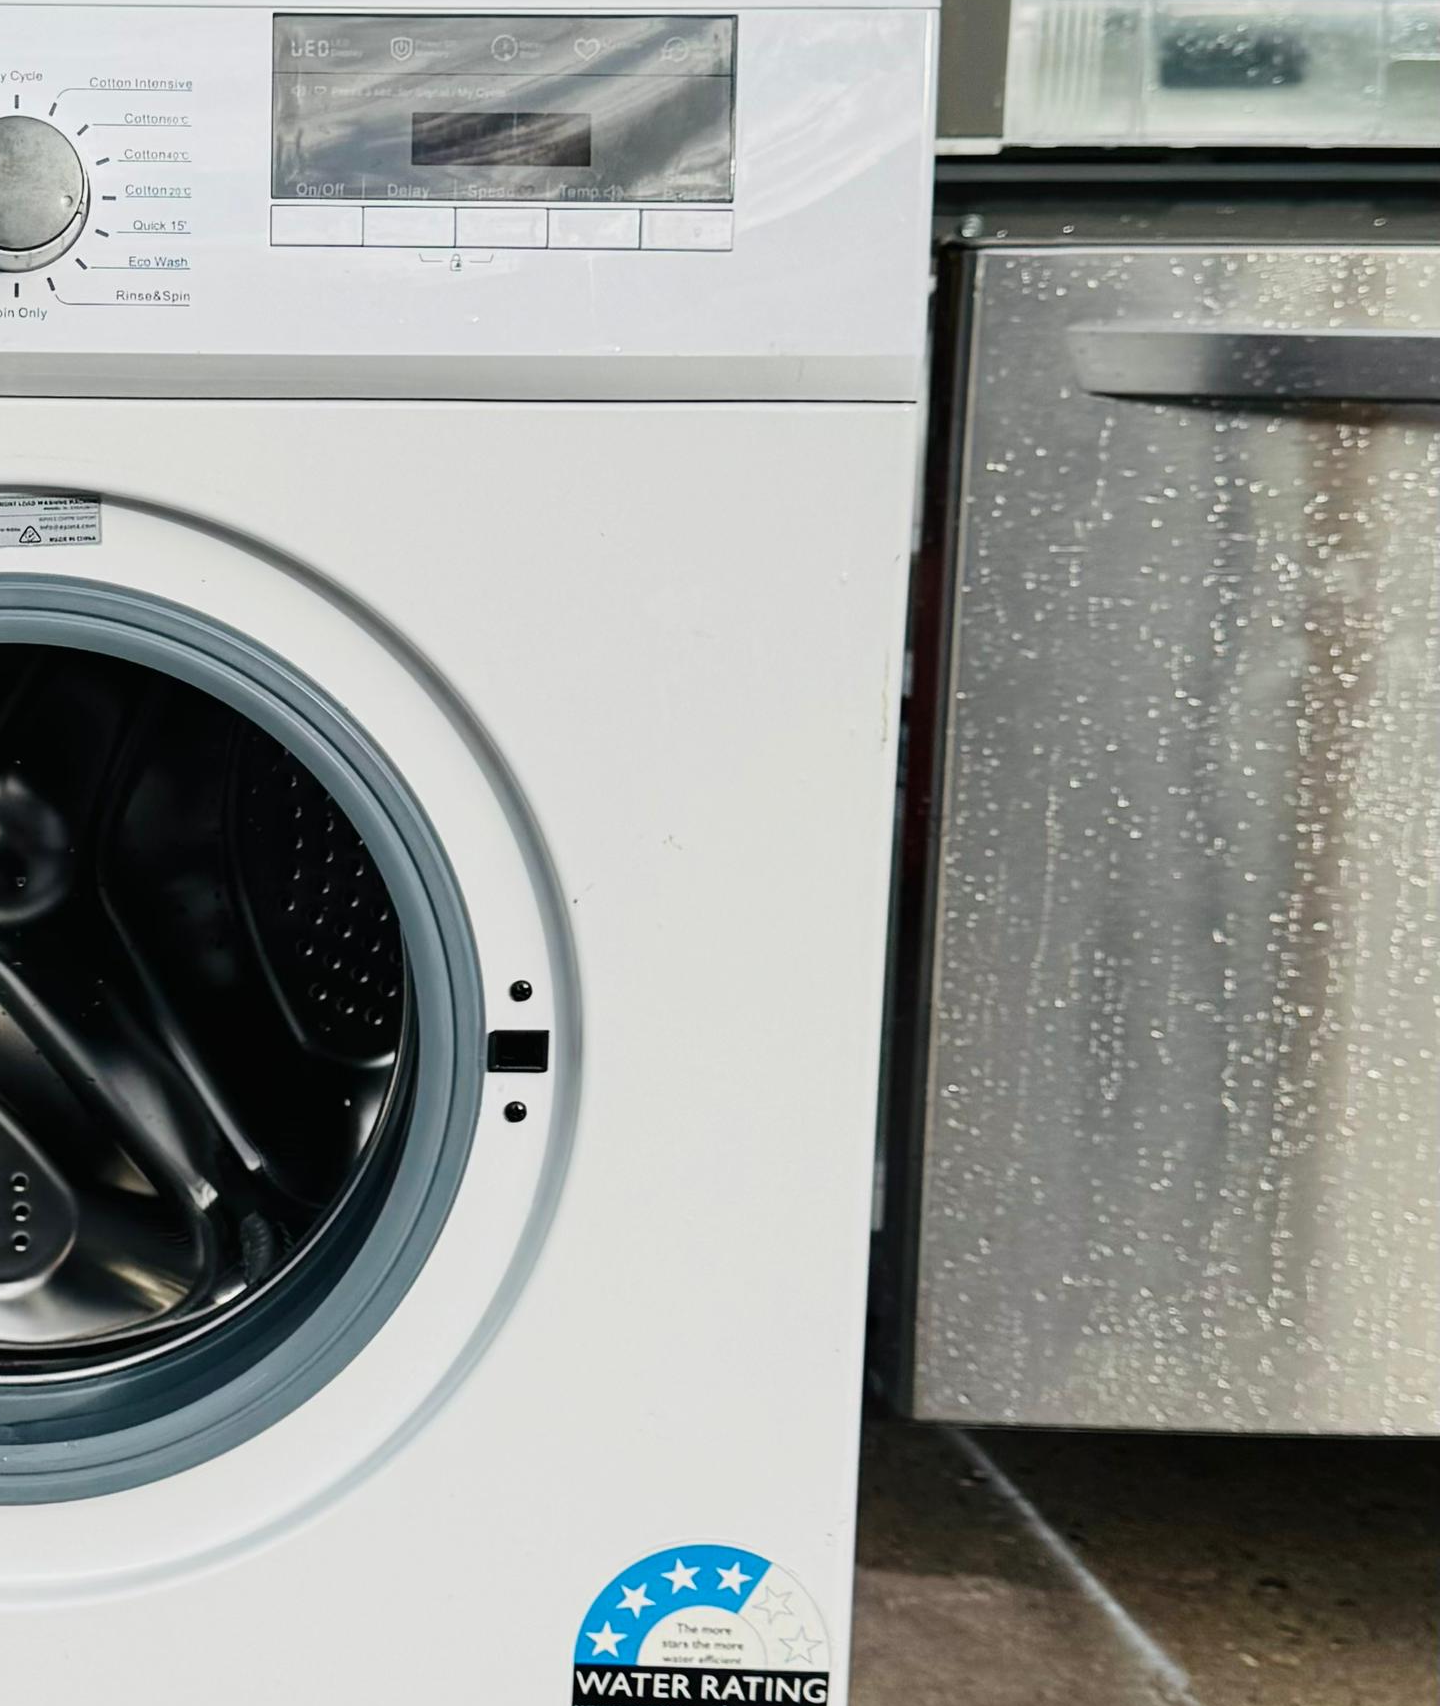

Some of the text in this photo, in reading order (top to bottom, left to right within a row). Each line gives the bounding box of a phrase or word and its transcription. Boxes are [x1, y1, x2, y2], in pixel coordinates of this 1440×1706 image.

[291, 40, 329, 57] LED
[10, 70, 43, 83] Cycle
[89, 77, 193, 90] Cotton Intensive
[296, 183, 345, 196] On/Off
[387, 184, 431, 198] Delay
[133, 220, 166, 231] Quick
[128, 256, 188, 267] Eco Wash
[18, 307, 47, 321] Only
[677, 1622, 731, 1635] The more
[662, 1639, 743, 1651] stars the more
[576, 1671, 827, 1704] WATER RATING
